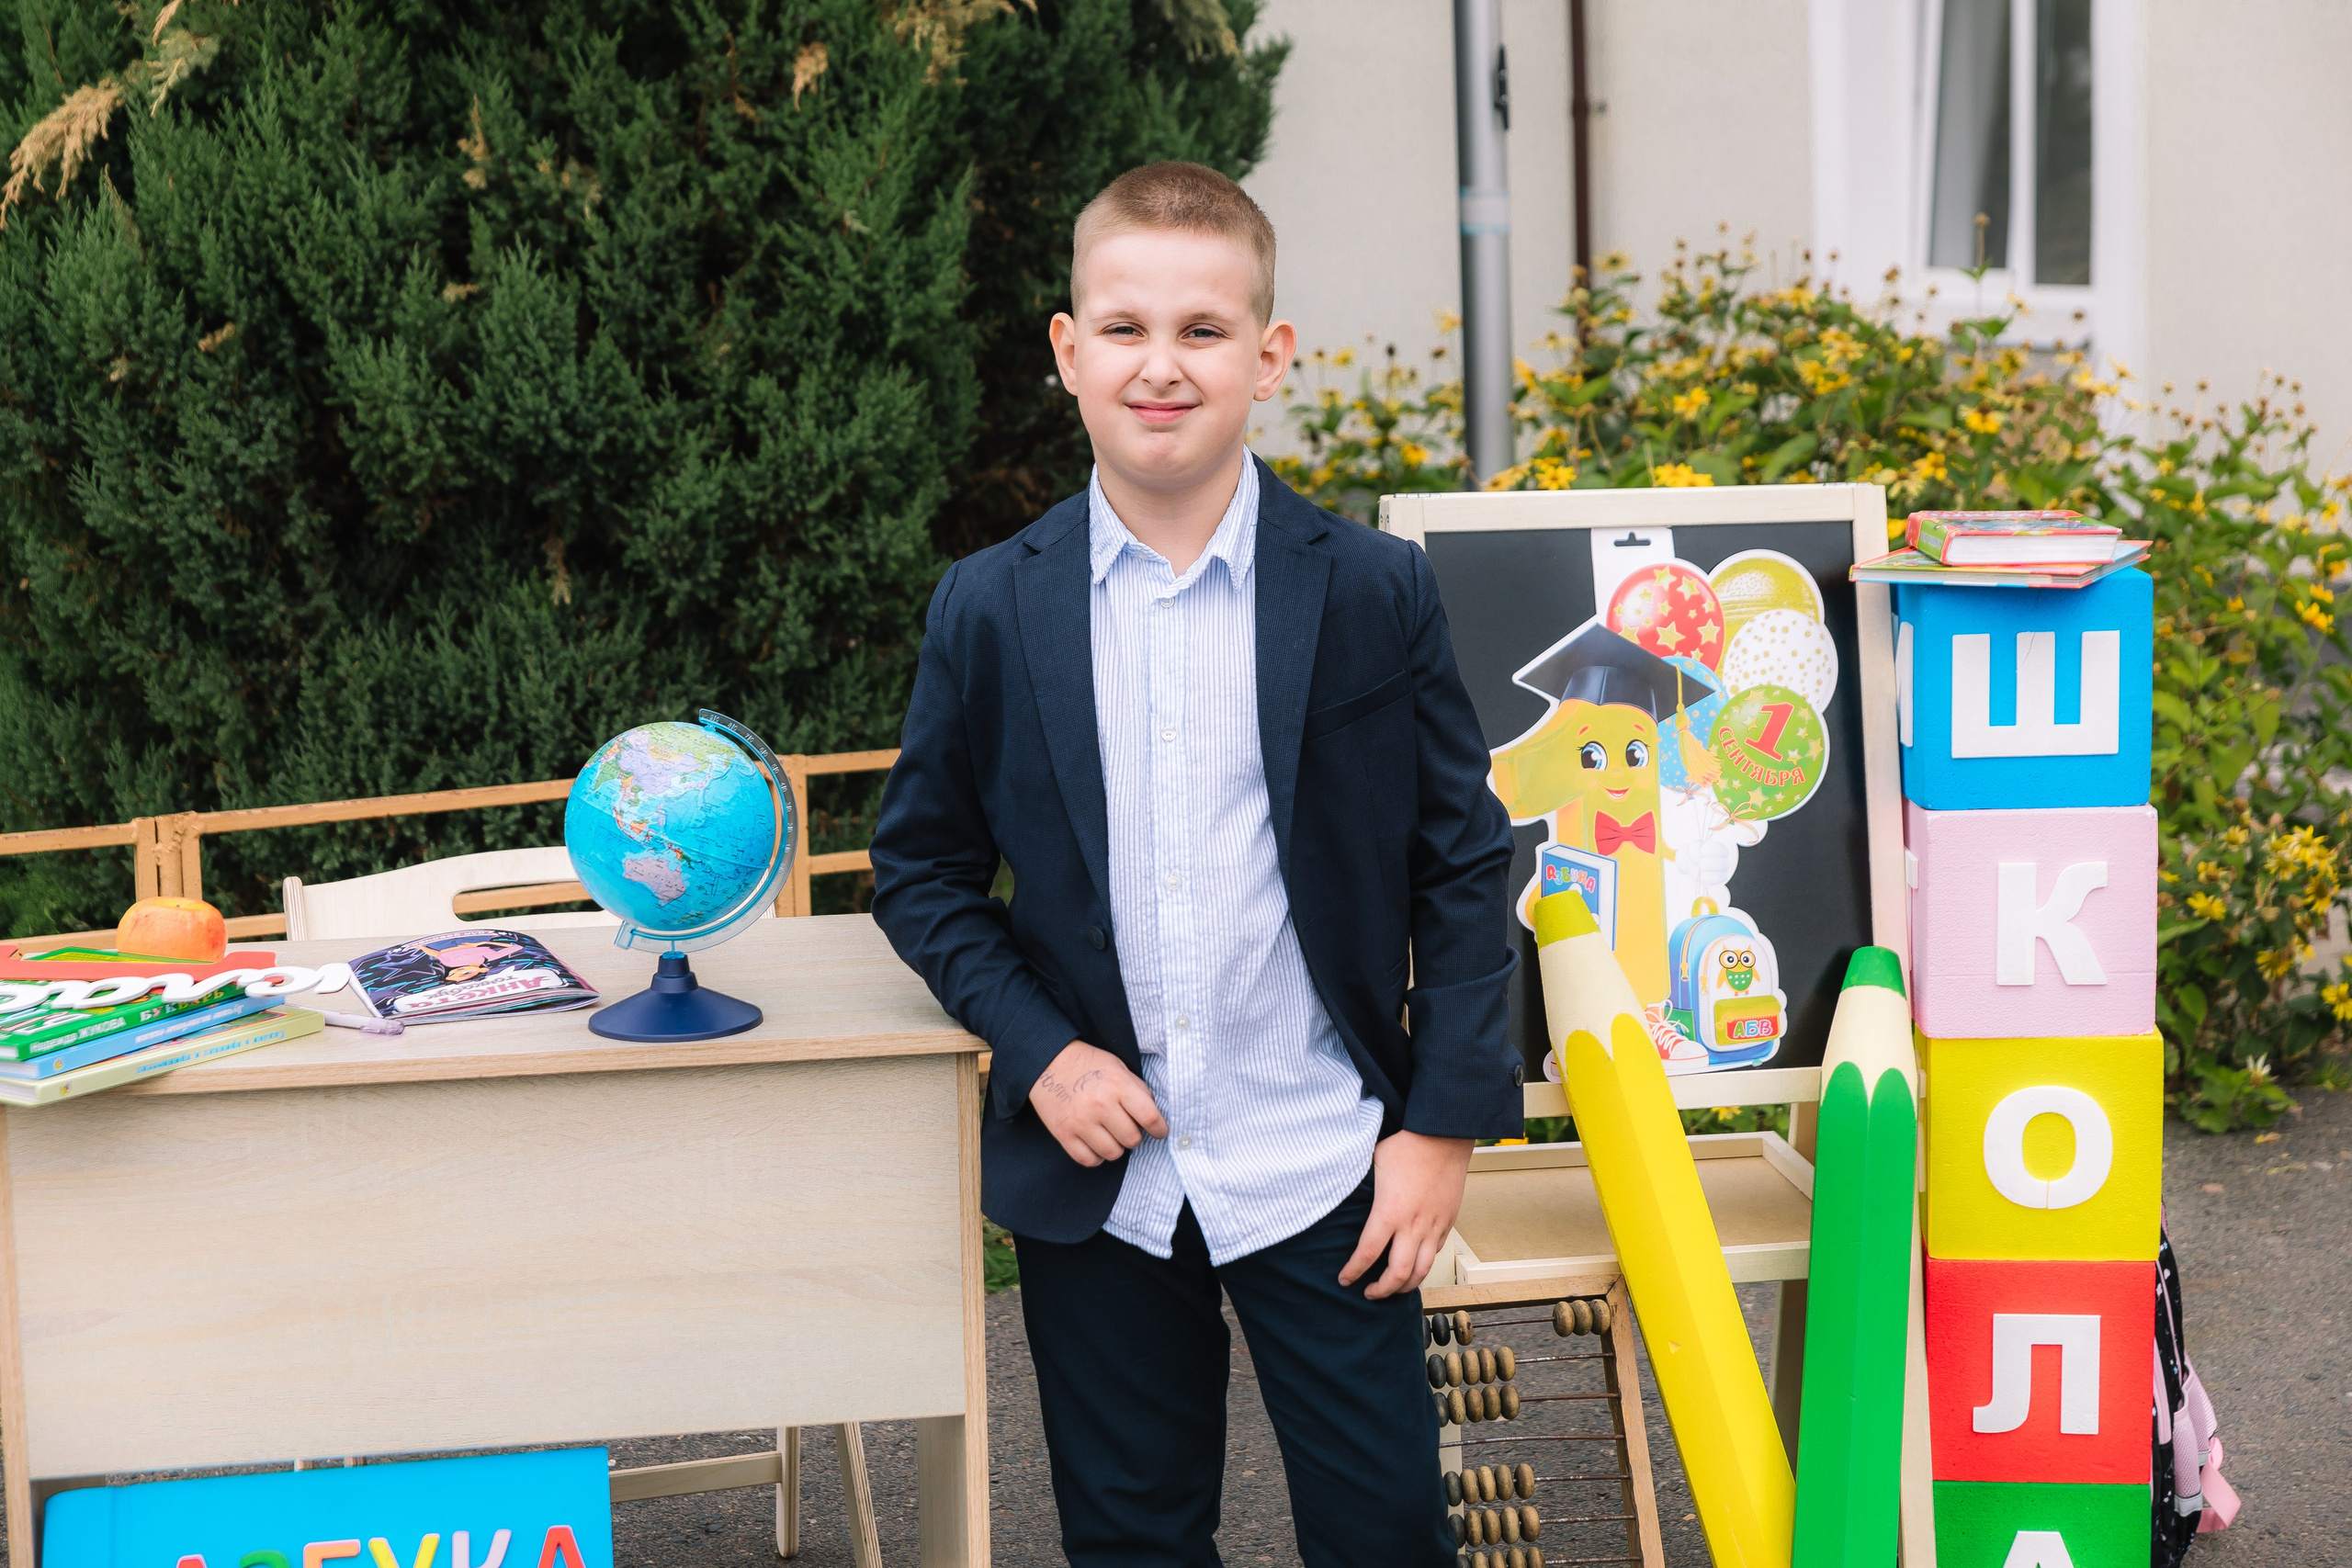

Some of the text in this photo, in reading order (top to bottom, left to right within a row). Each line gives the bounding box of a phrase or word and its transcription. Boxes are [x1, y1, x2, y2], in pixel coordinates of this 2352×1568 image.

[1744, 702, 1795, 762] 1
[1718, 726, 1806, 787] СЕНТЯБРЯ
[1546, 864, 1597, 893] АЗБУКА
[406, 976, 551, 1009] Анкета
[78, 1017, 127, 1039] ЖУКОВА
[1734, 1020, 1773, 1039] АБВ
